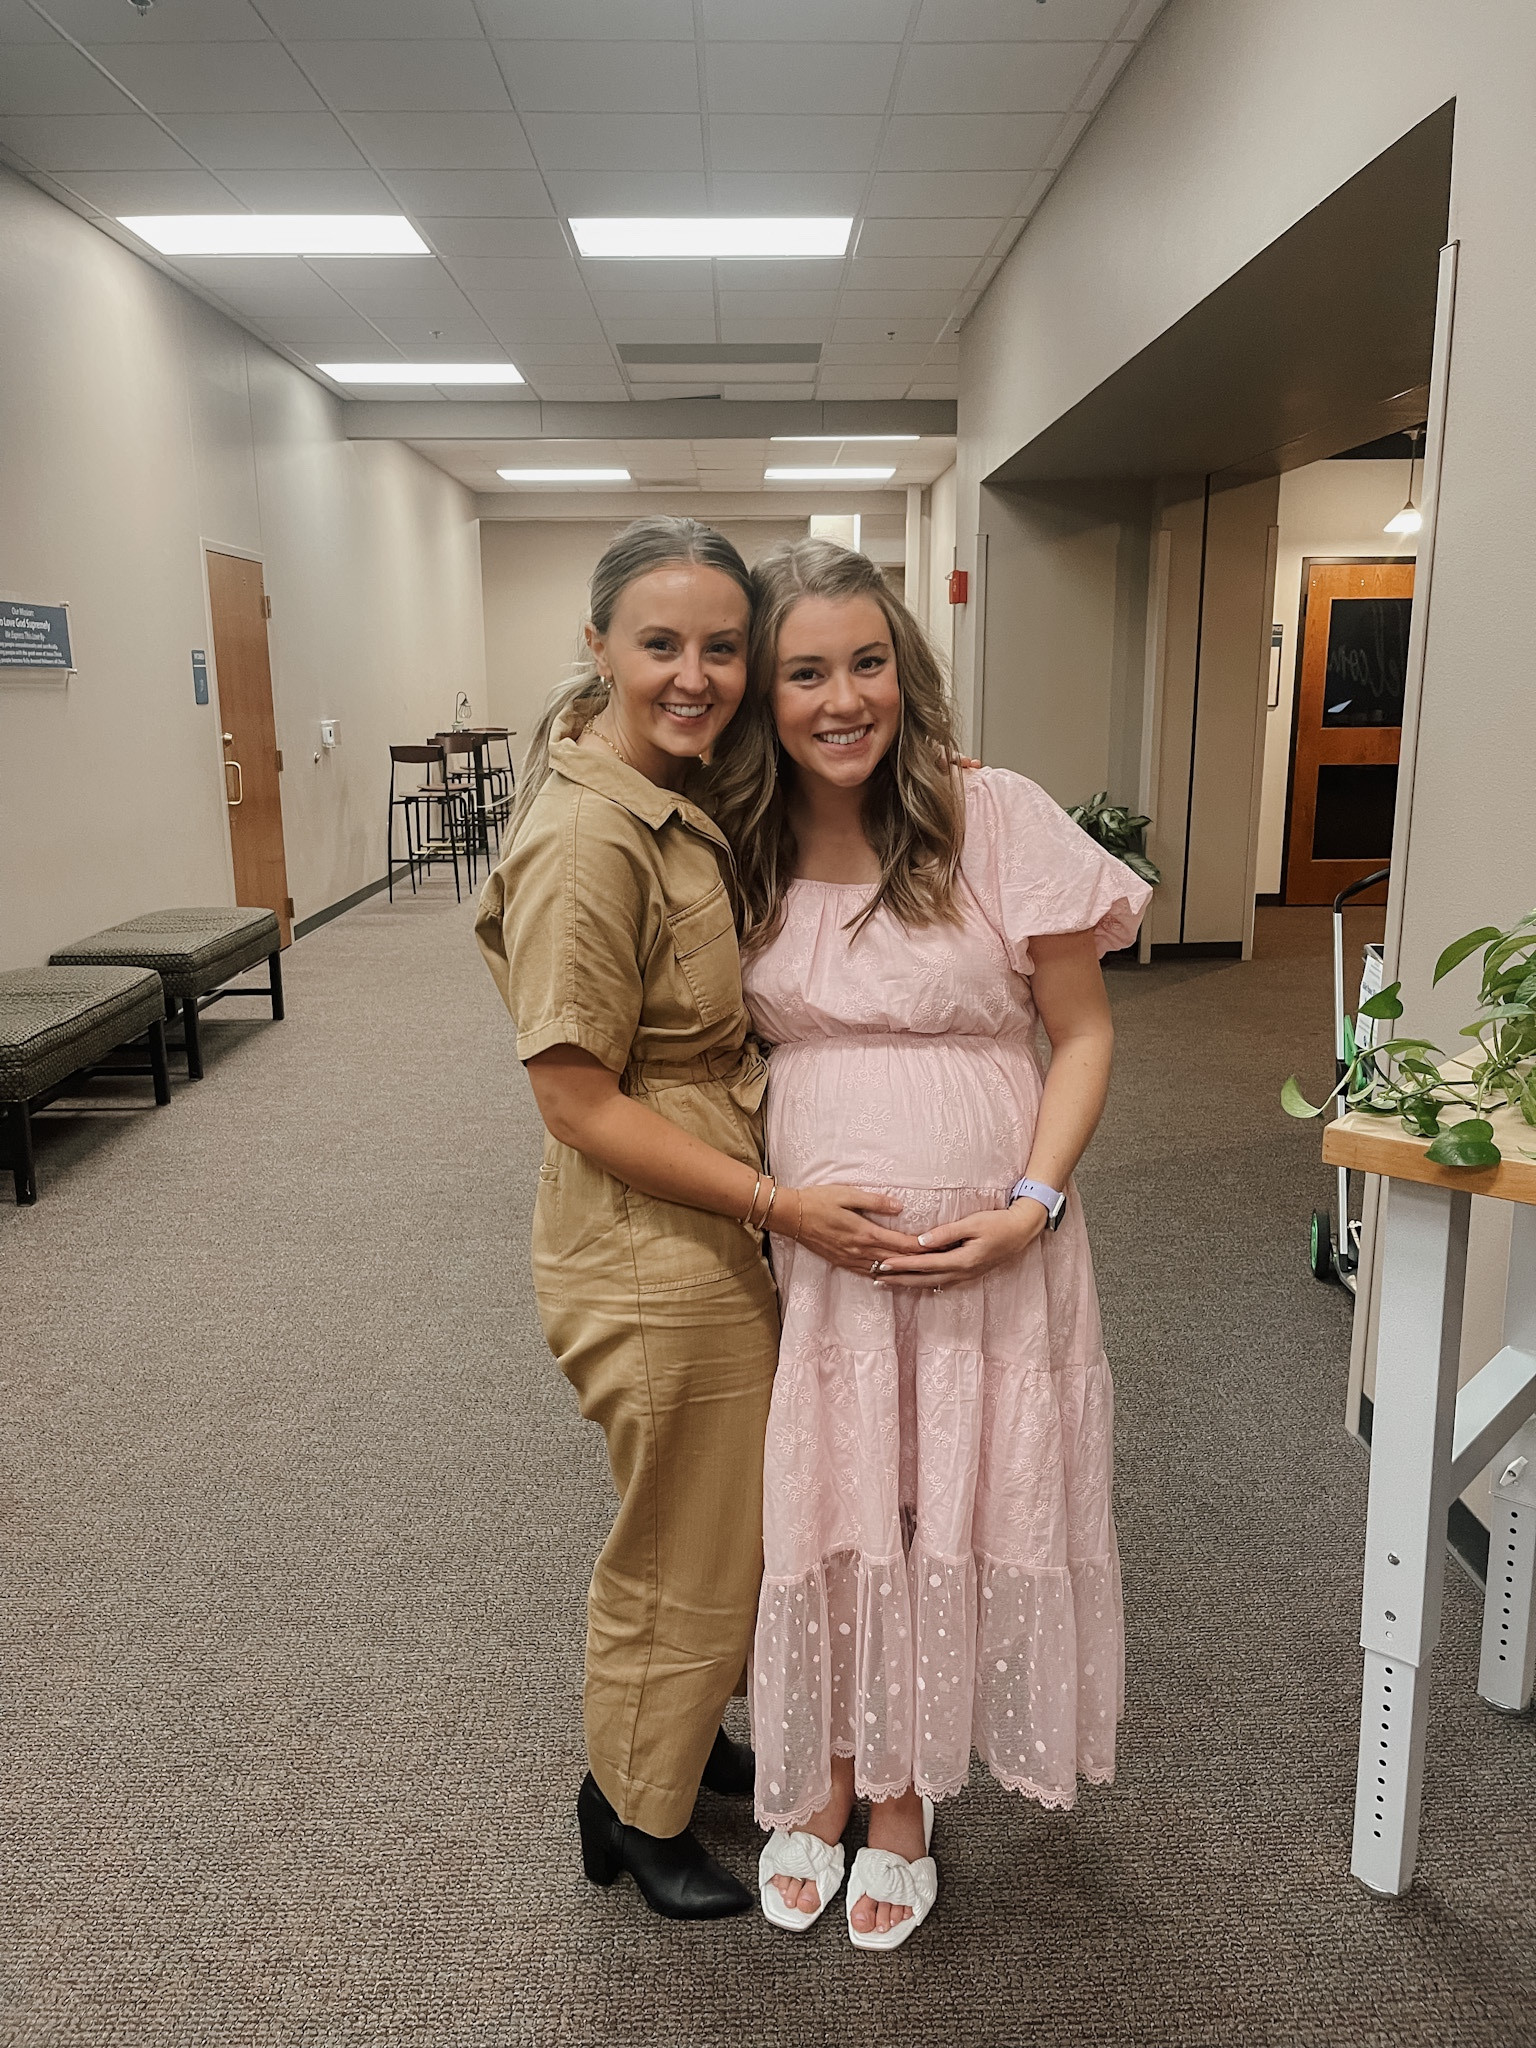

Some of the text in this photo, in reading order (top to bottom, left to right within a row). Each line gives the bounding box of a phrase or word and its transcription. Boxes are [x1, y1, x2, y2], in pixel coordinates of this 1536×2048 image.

[3, 616, 16, 628] Love
[16, 617, 26, 628] God
[26, 618, 51, 633] Supremely
